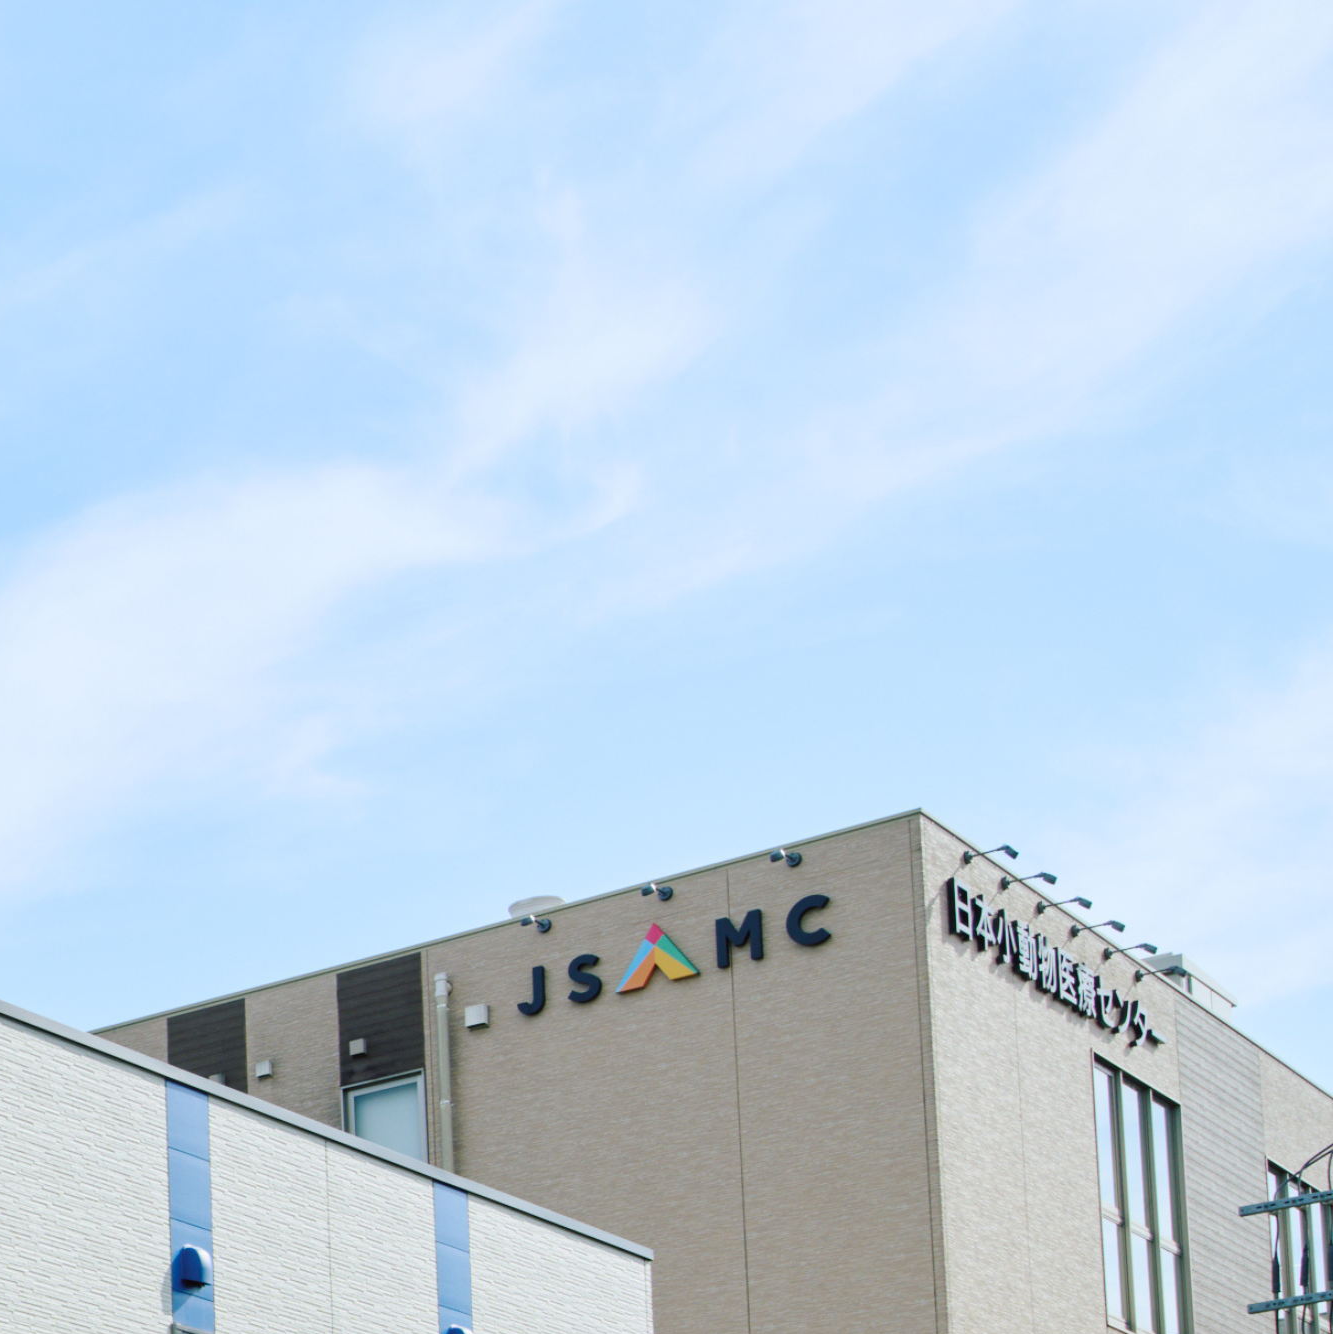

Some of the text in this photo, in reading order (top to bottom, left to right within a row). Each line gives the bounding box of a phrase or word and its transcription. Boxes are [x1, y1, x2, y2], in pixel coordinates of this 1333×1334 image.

[517, 894, 831, 1016] JSAMC
[947, 877, 1166, 1047] 日本小動物医療センター
